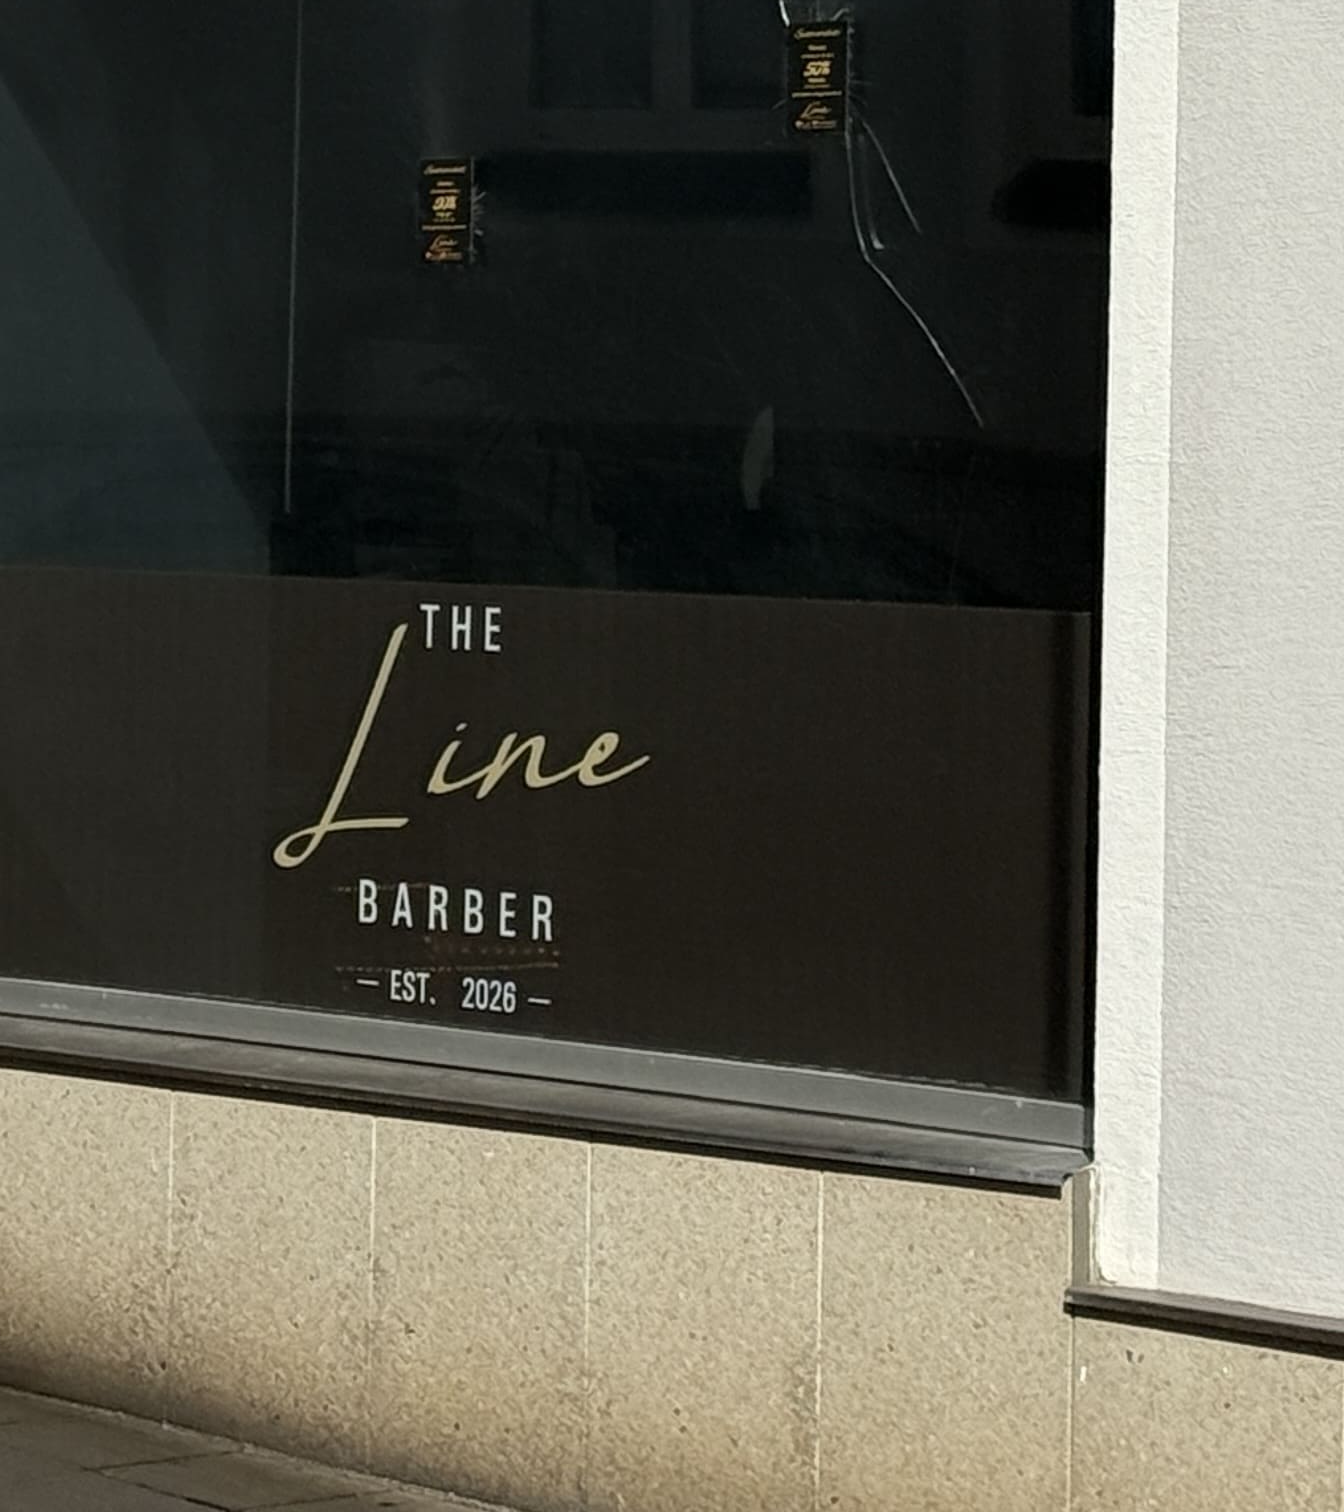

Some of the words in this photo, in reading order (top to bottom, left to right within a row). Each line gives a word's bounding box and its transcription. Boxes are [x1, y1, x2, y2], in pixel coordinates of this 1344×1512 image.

[420, 604, 502, 652] THE
[273, 623, 650, 868] Line
[358, 879, 554, 942] BARBER
[390, 969, 437, 1006] EST.
[462, 977, 516, 1013] 2026
